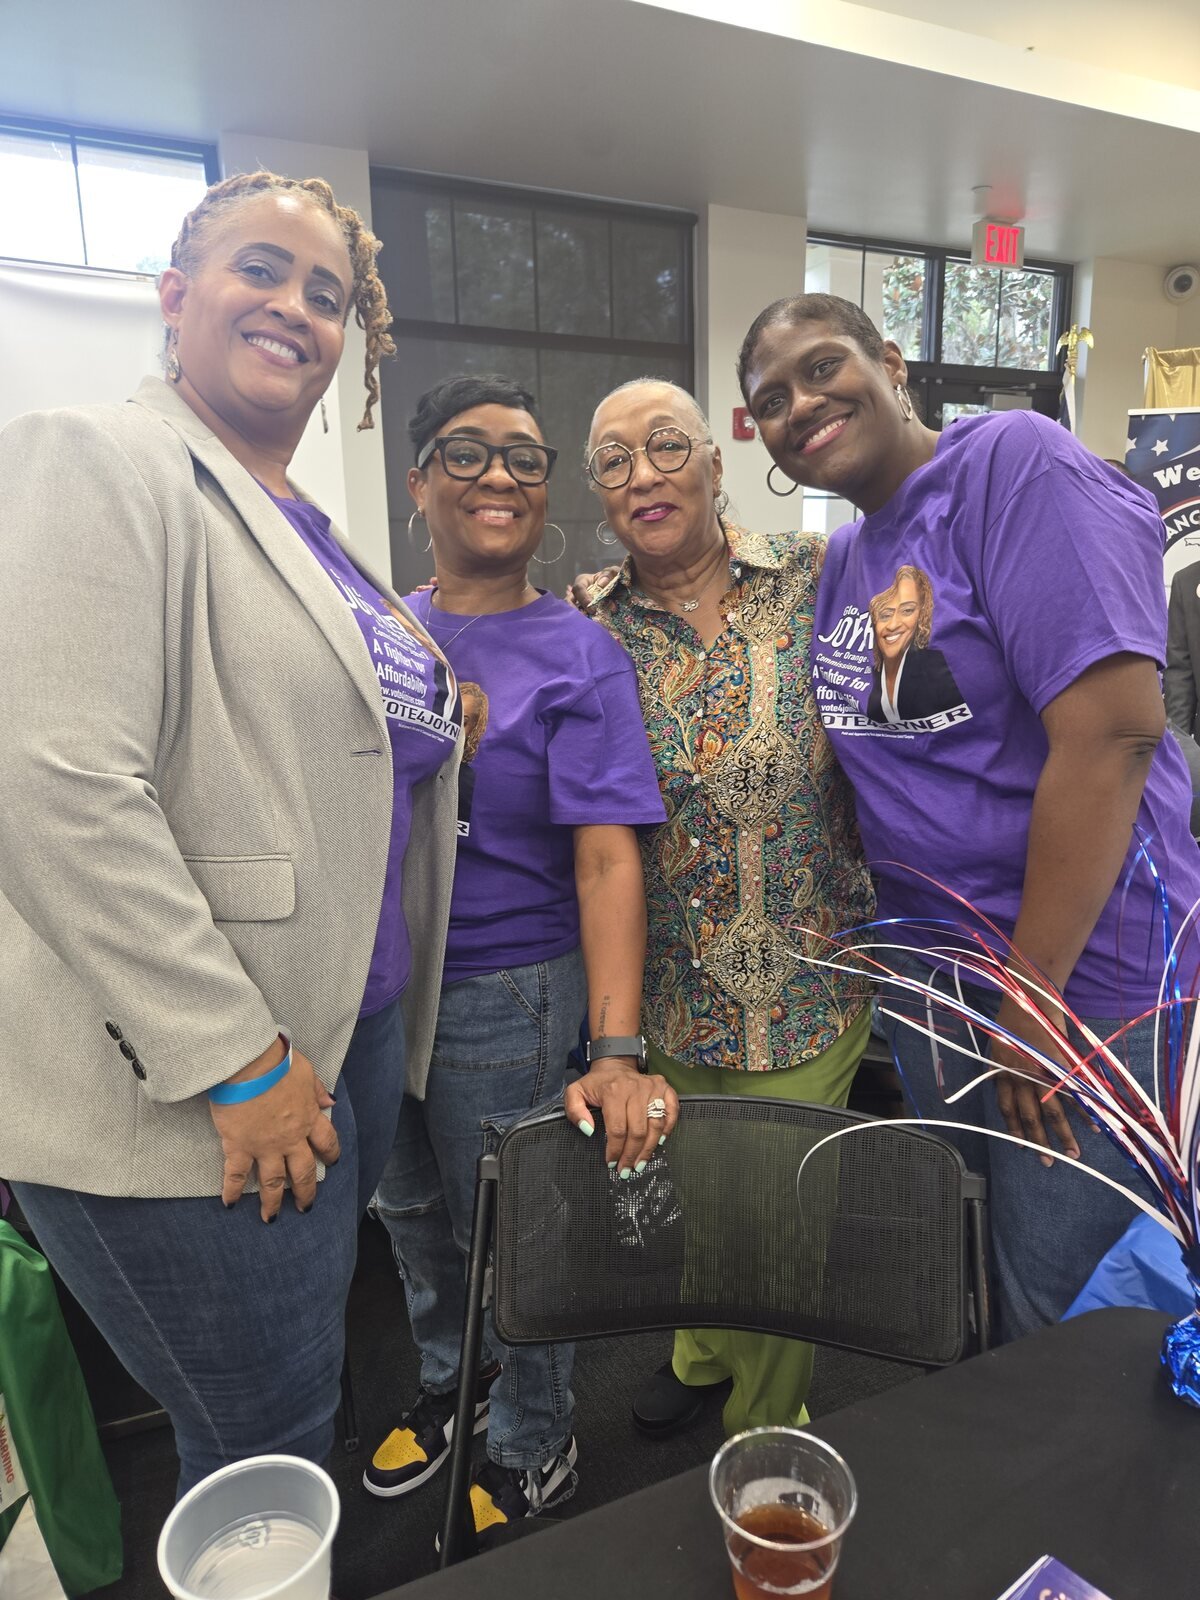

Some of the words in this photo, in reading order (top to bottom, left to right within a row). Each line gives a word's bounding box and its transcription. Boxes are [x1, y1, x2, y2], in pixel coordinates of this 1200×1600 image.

[985, 224, 1020, 265] EXIT
[373, 638, 384, 655] A
[816, 653, 865, 673] Commissioner
[812, 664, 820, 679] A
[848, 677, 871, 692] for
[383, 699, 460, 740] OTE4JOYN
